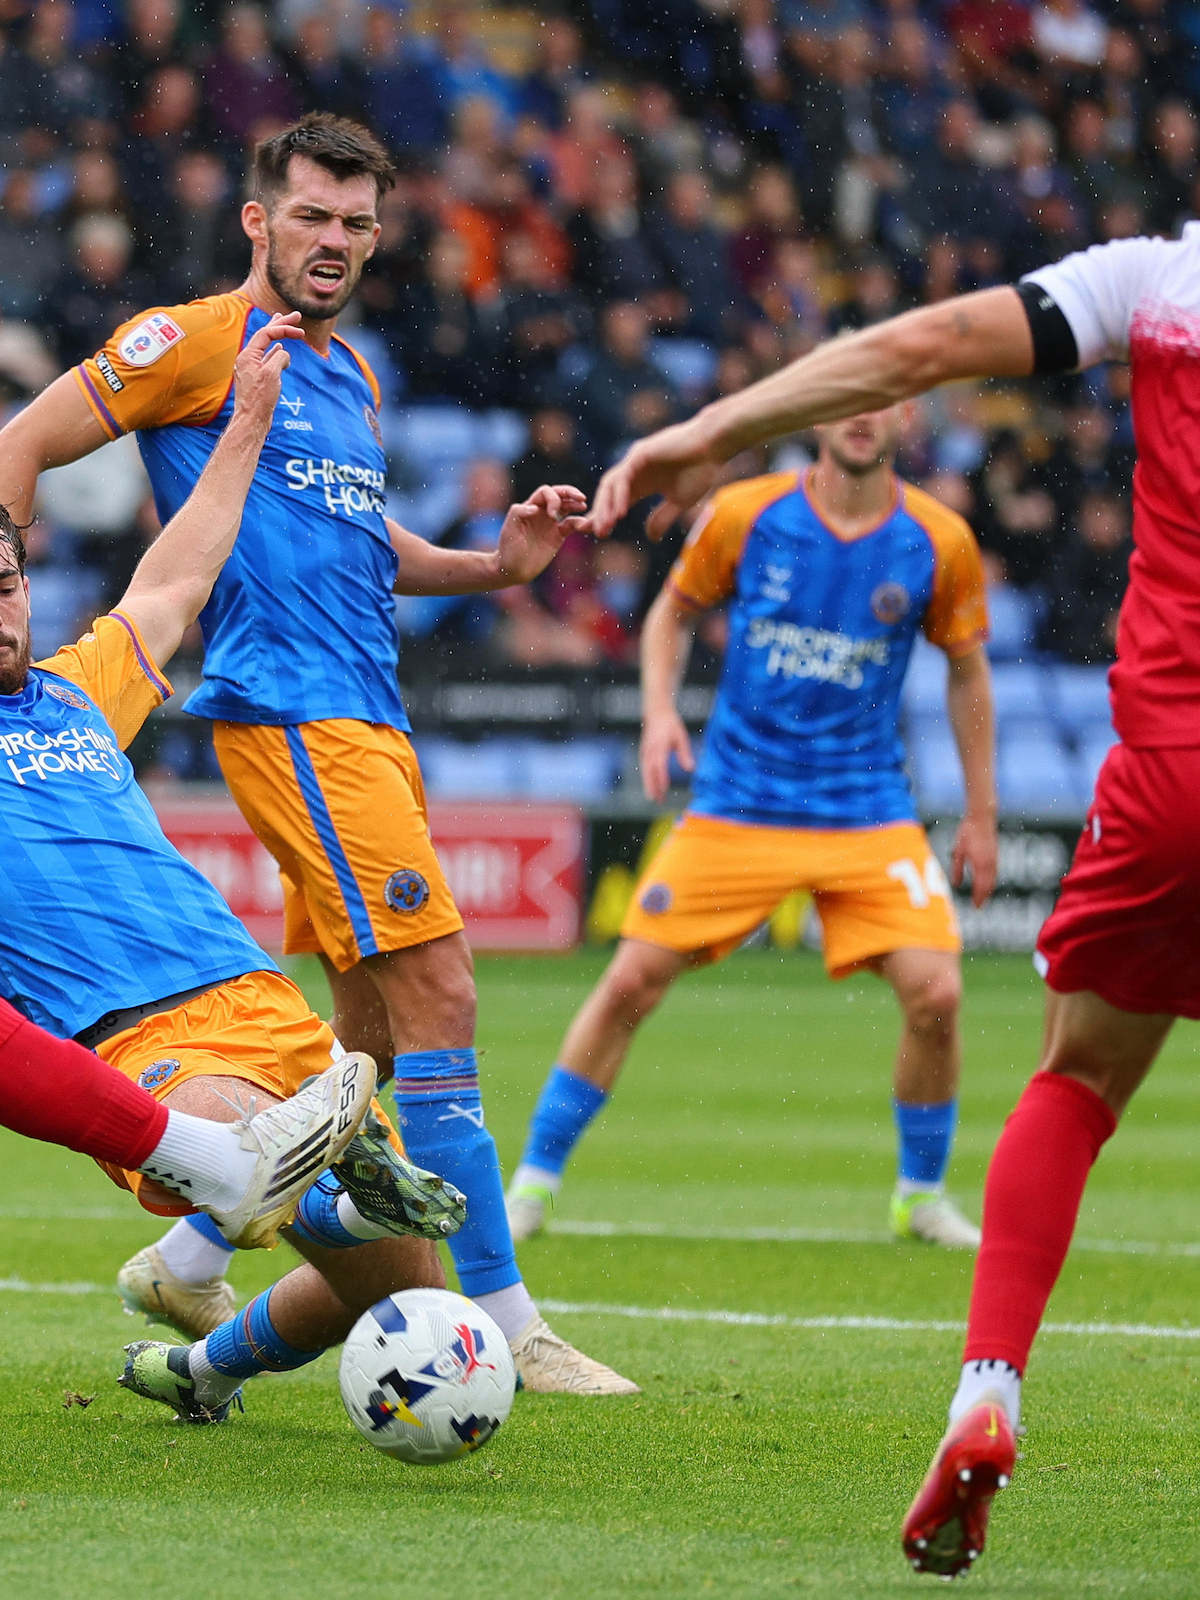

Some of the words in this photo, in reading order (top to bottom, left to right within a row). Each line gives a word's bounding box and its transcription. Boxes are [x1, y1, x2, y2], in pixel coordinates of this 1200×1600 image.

[125, 346, 137, 359] EFL
[283, 420, 314, 431] OXEN
[7, 750, 121, 786] HOMES
[337, 1062, 359, 1135] F50
